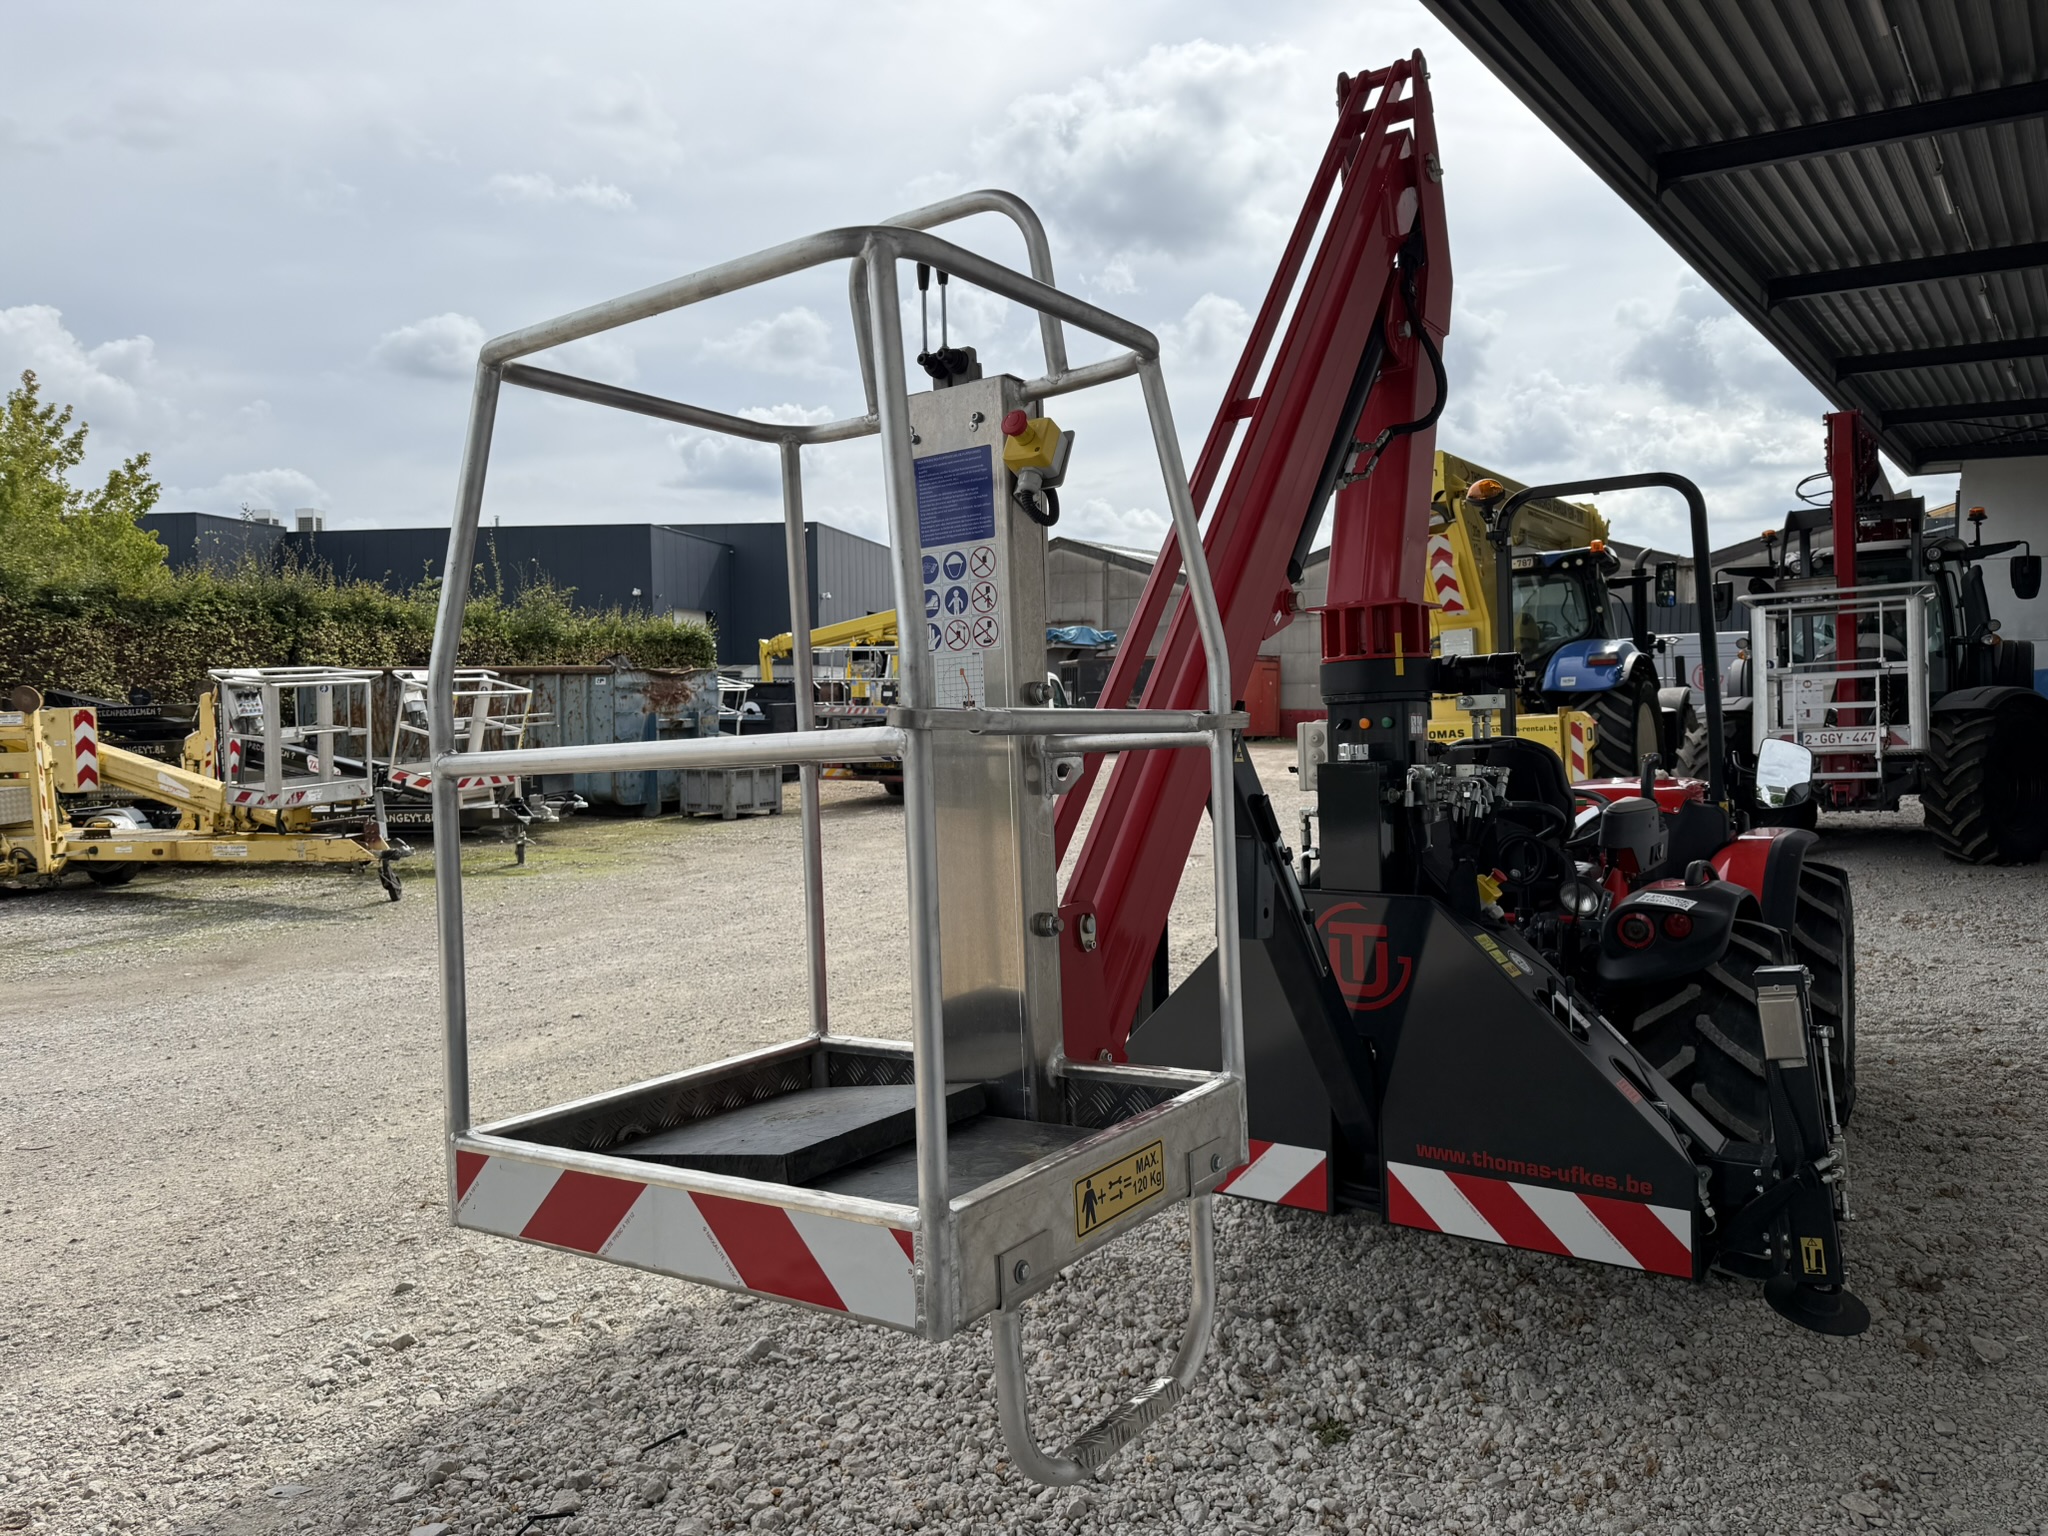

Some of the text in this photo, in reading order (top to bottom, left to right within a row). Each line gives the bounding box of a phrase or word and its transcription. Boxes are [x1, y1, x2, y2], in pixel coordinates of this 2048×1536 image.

[97, 707, 156, 717] TEENPROBLEMEN
[1429, 729, 1465, 739] OMAS
[123, 745, 166, 754] NGEYT.BE
[1136, 1151, 1159, 1174] MAX.
[1416, 1143, 1653, 1196] www.thomas-ufkes.be
[1133, 1170, 1162, 1195] 120 Kg
